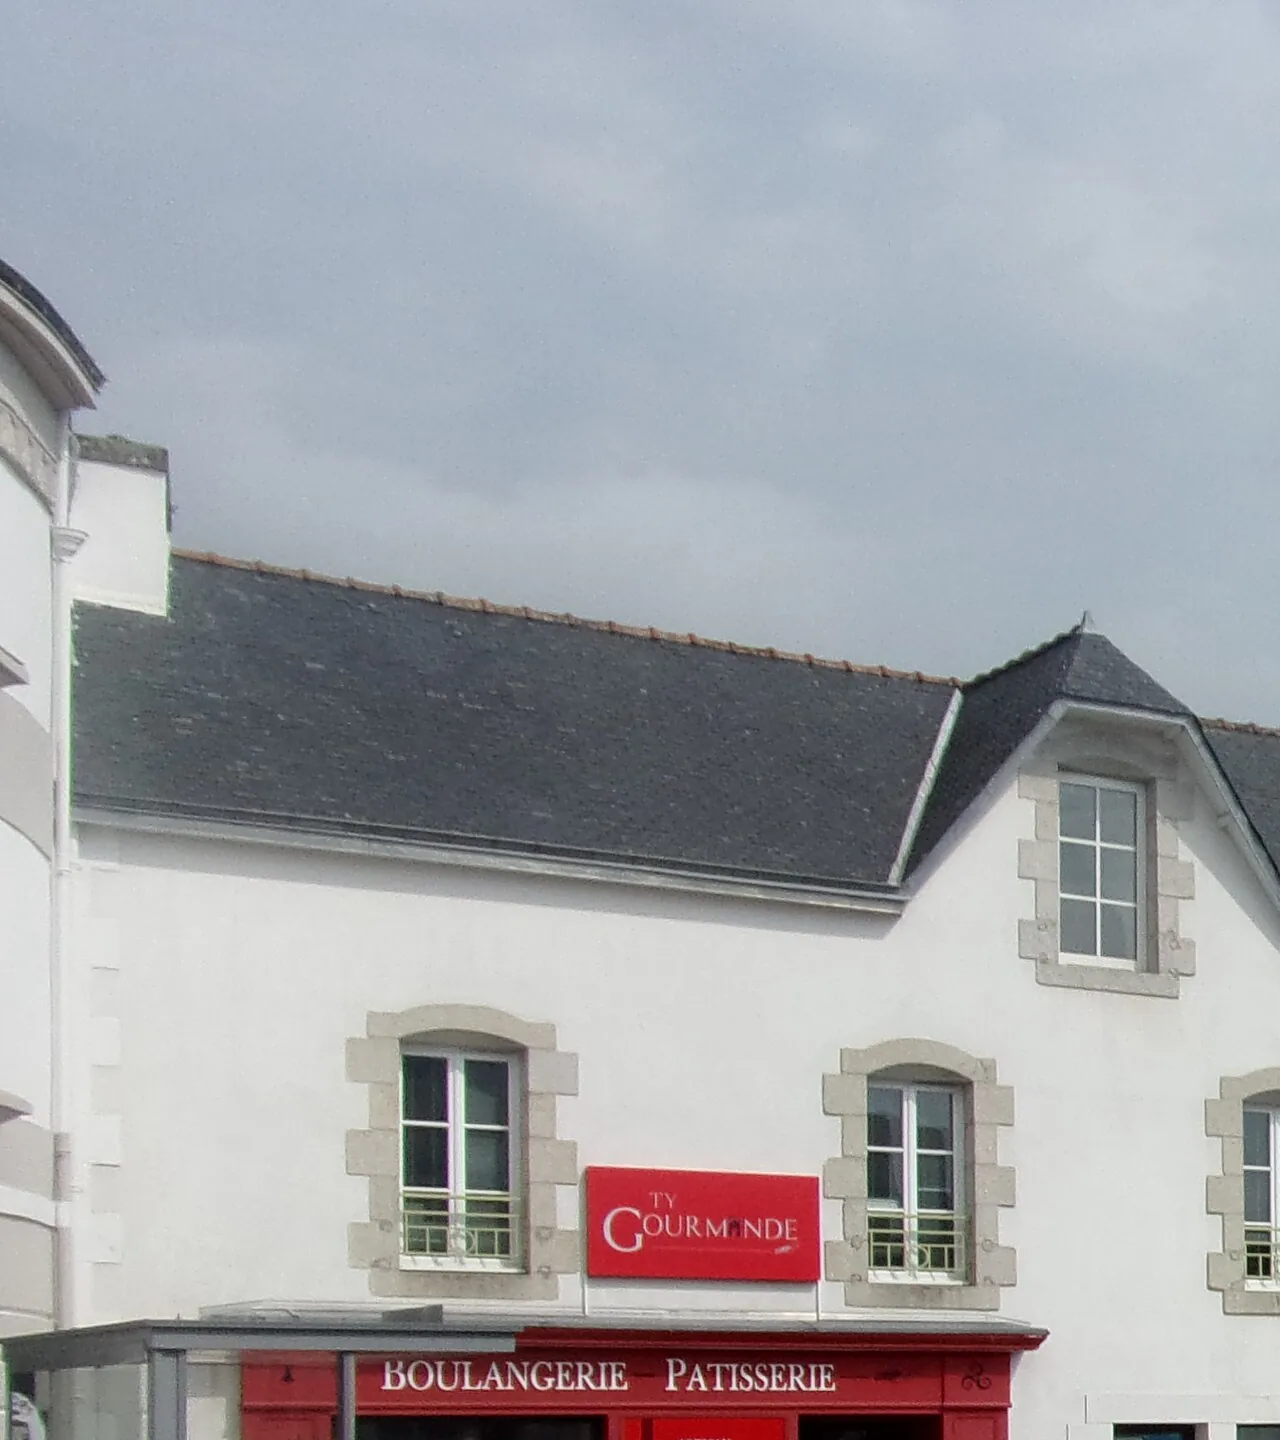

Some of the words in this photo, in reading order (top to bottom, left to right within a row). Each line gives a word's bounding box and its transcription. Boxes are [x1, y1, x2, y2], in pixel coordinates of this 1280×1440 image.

[650, 1192, 677, 1209] TY
[381, 1359, 628, 1391] BOULANGERIE
[665, 1358, 836, 1392] PATISSERIE
